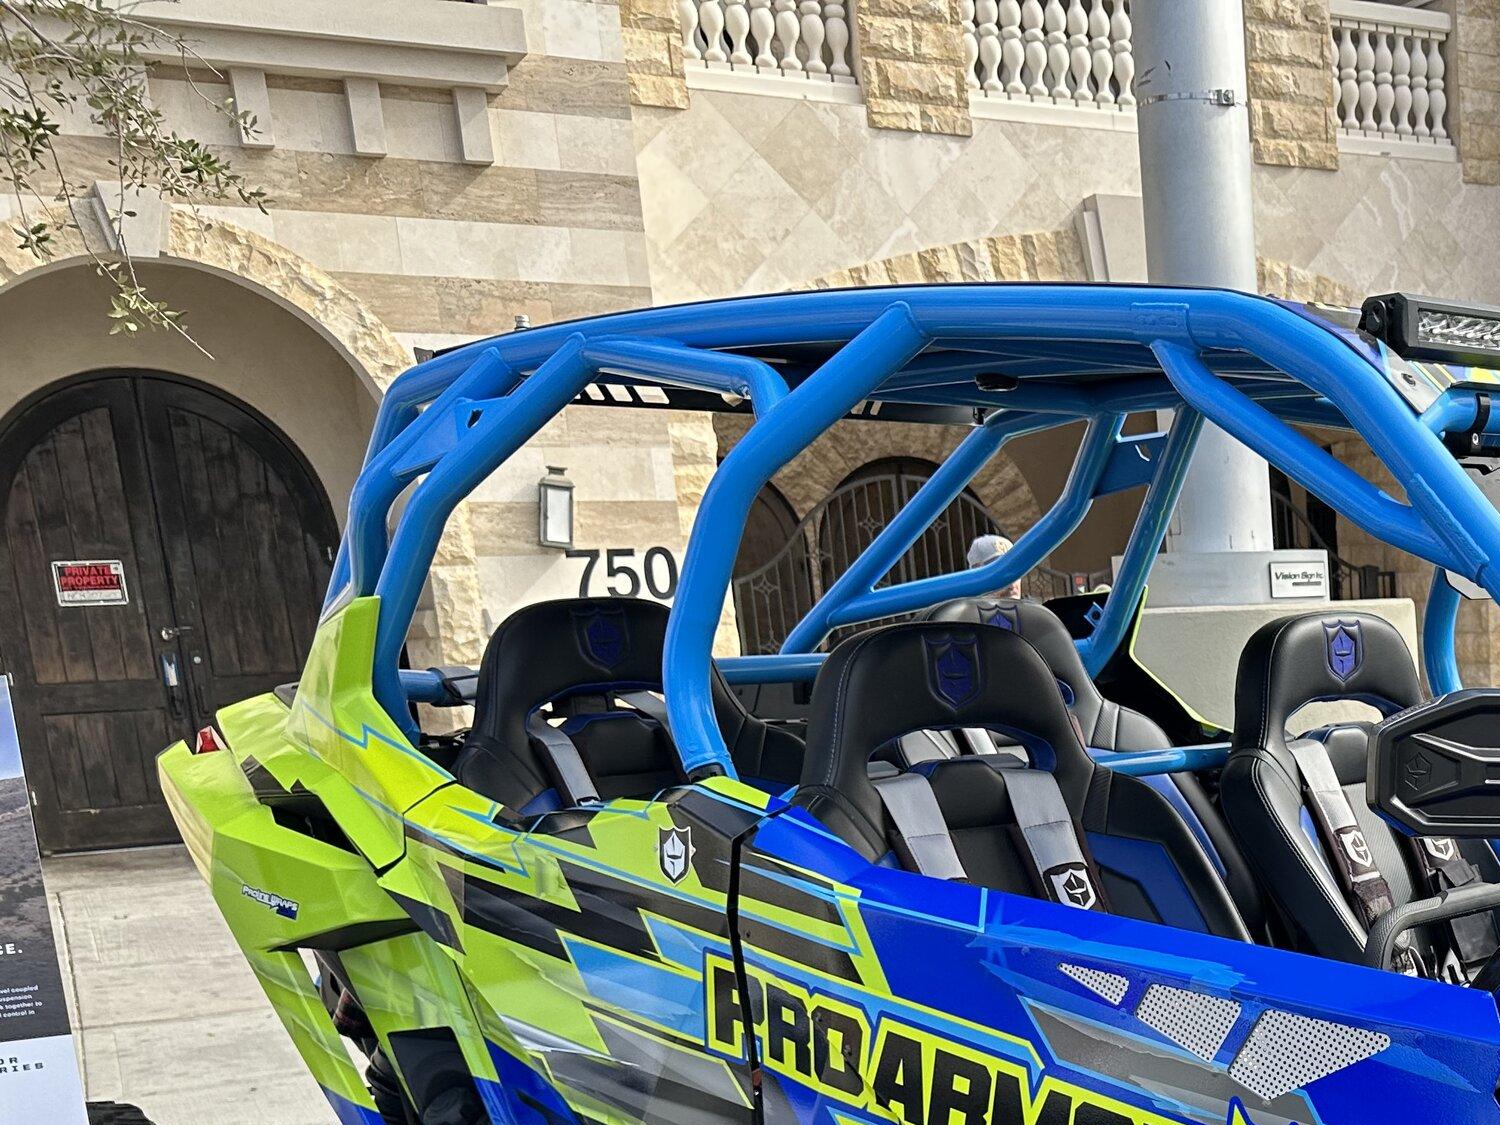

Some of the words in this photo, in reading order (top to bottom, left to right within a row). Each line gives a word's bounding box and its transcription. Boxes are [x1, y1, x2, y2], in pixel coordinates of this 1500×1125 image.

[60, 576, 118, 586] PROPERTY
[565, 546, 678, 600] 750
[713, 966, 865, 1099] PRO
